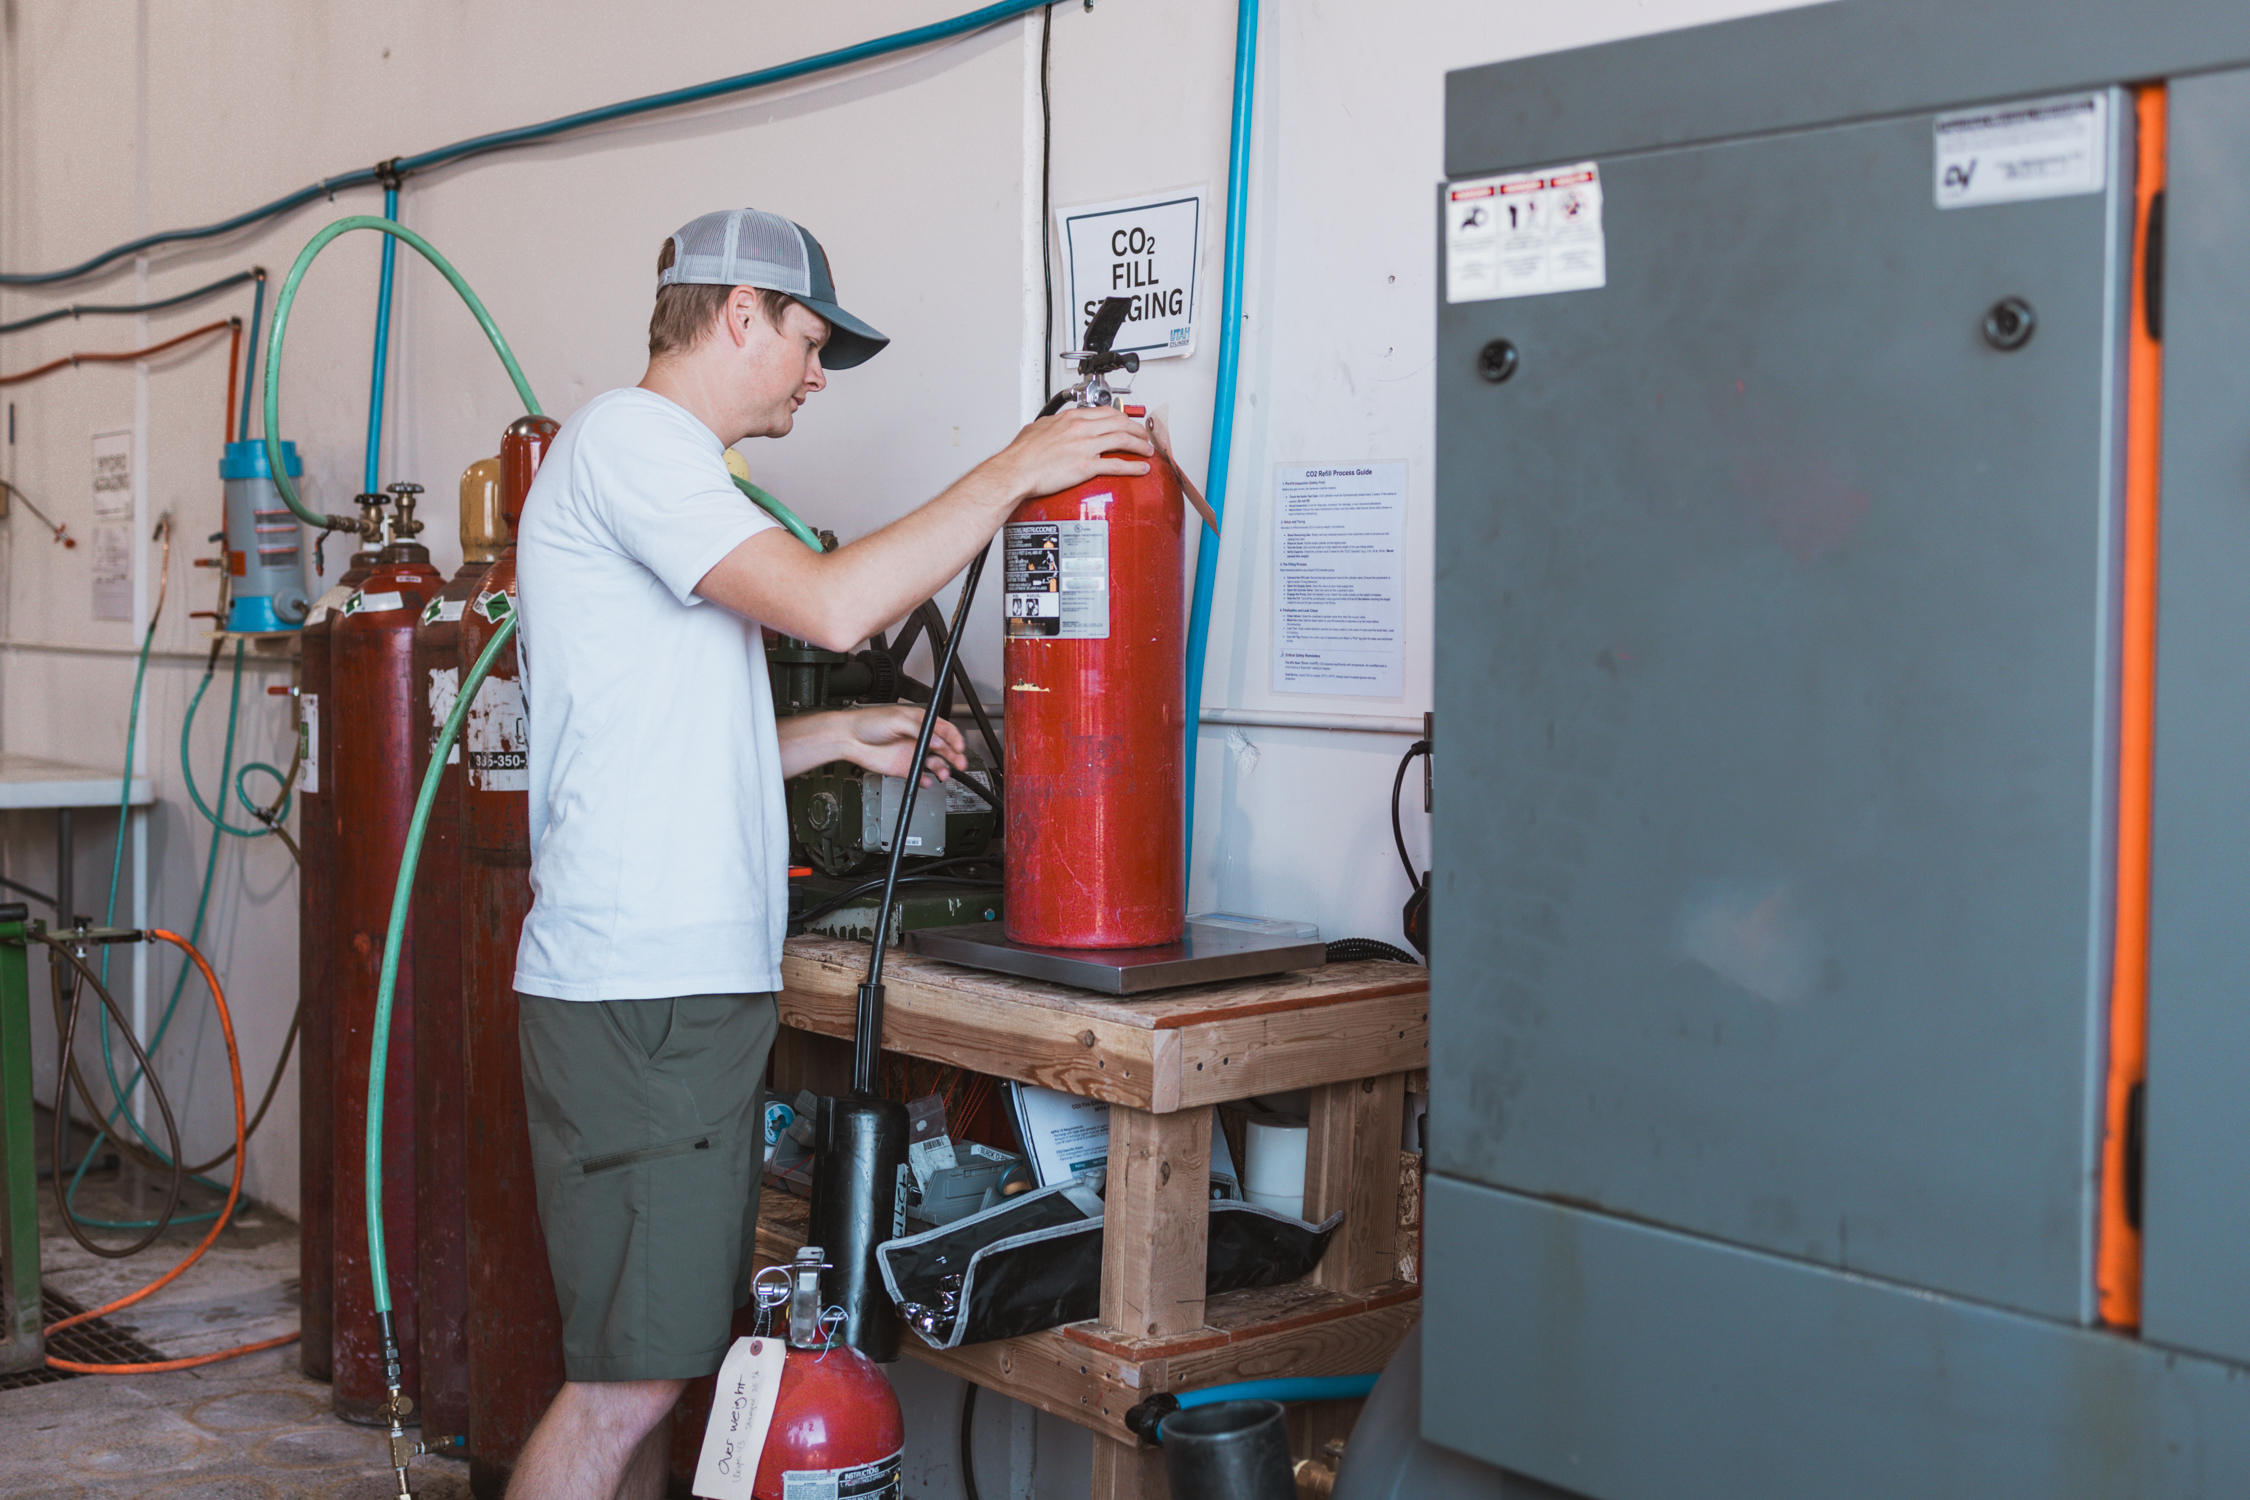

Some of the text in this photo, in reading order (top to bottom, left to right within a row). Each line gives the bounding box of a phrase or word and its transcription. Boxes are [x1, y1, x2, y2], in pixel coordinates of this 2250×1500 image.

[1112, 259, 1159, 290] FILL
[1084, 288, 1183, 327] SGING
[1170, 327, 1191, 341] UTAH
[1306, 470, 1317, 478] CO2
[1356, 468, 1373, 476] Guide
[718, 1437, 734, 1475] Over
[844, 1465, 880, 1480] INSTRUCTIONS
